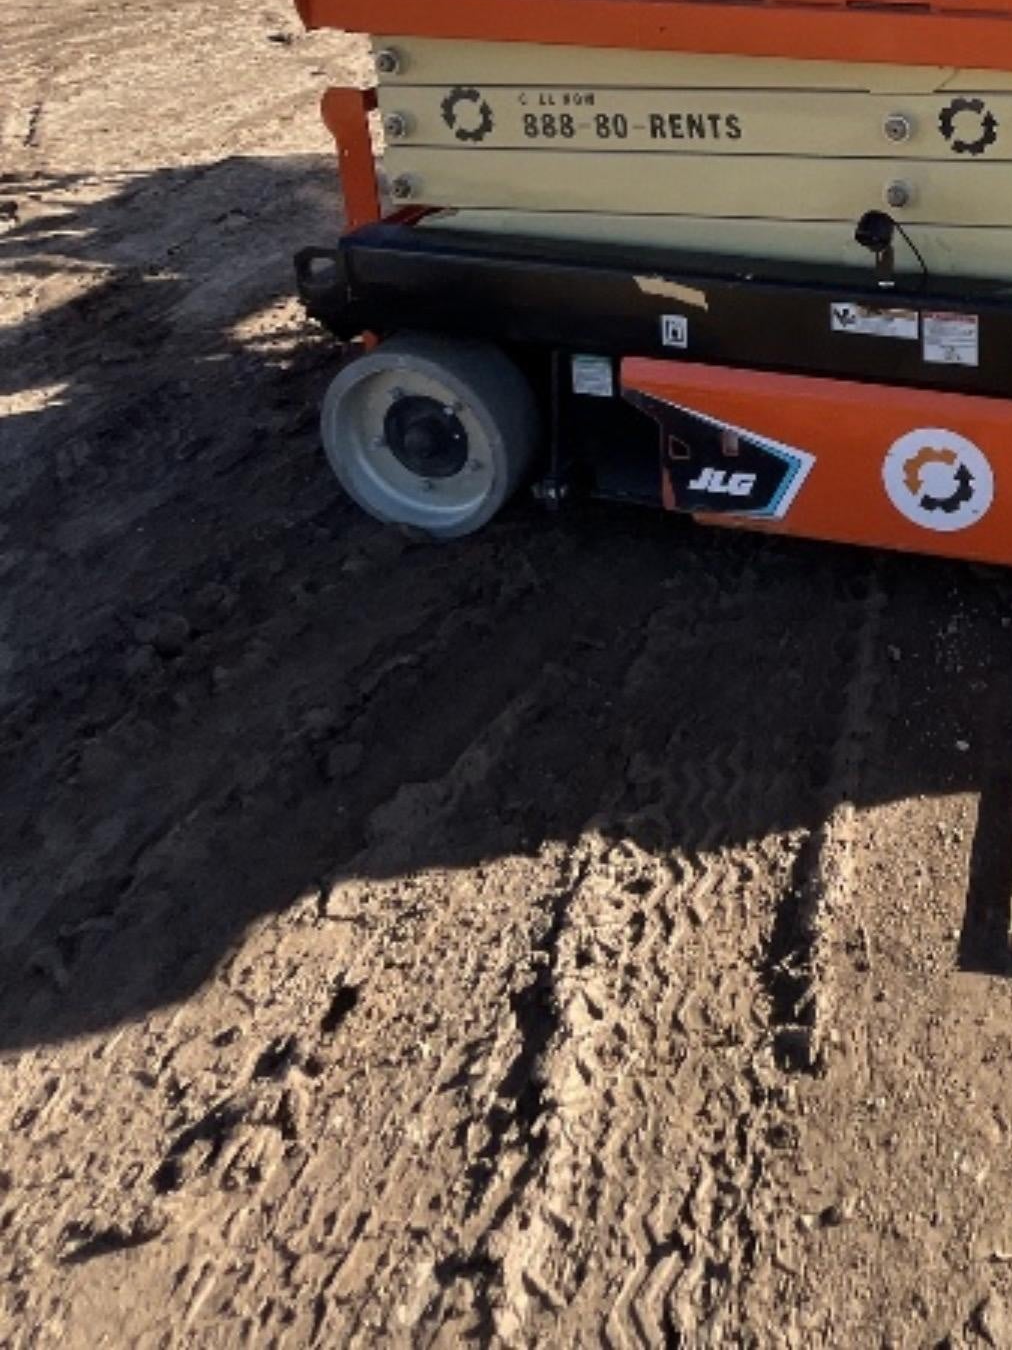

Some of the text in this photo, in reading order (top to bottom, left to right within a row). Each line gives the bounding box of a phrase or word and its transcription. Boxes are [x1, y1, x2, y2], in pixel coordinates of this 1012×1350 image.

[518, 92, 556, 106] CLL
[523, 113, 742, 139] 888-80-RENTS
[688, 467, 756, 496] JLG
